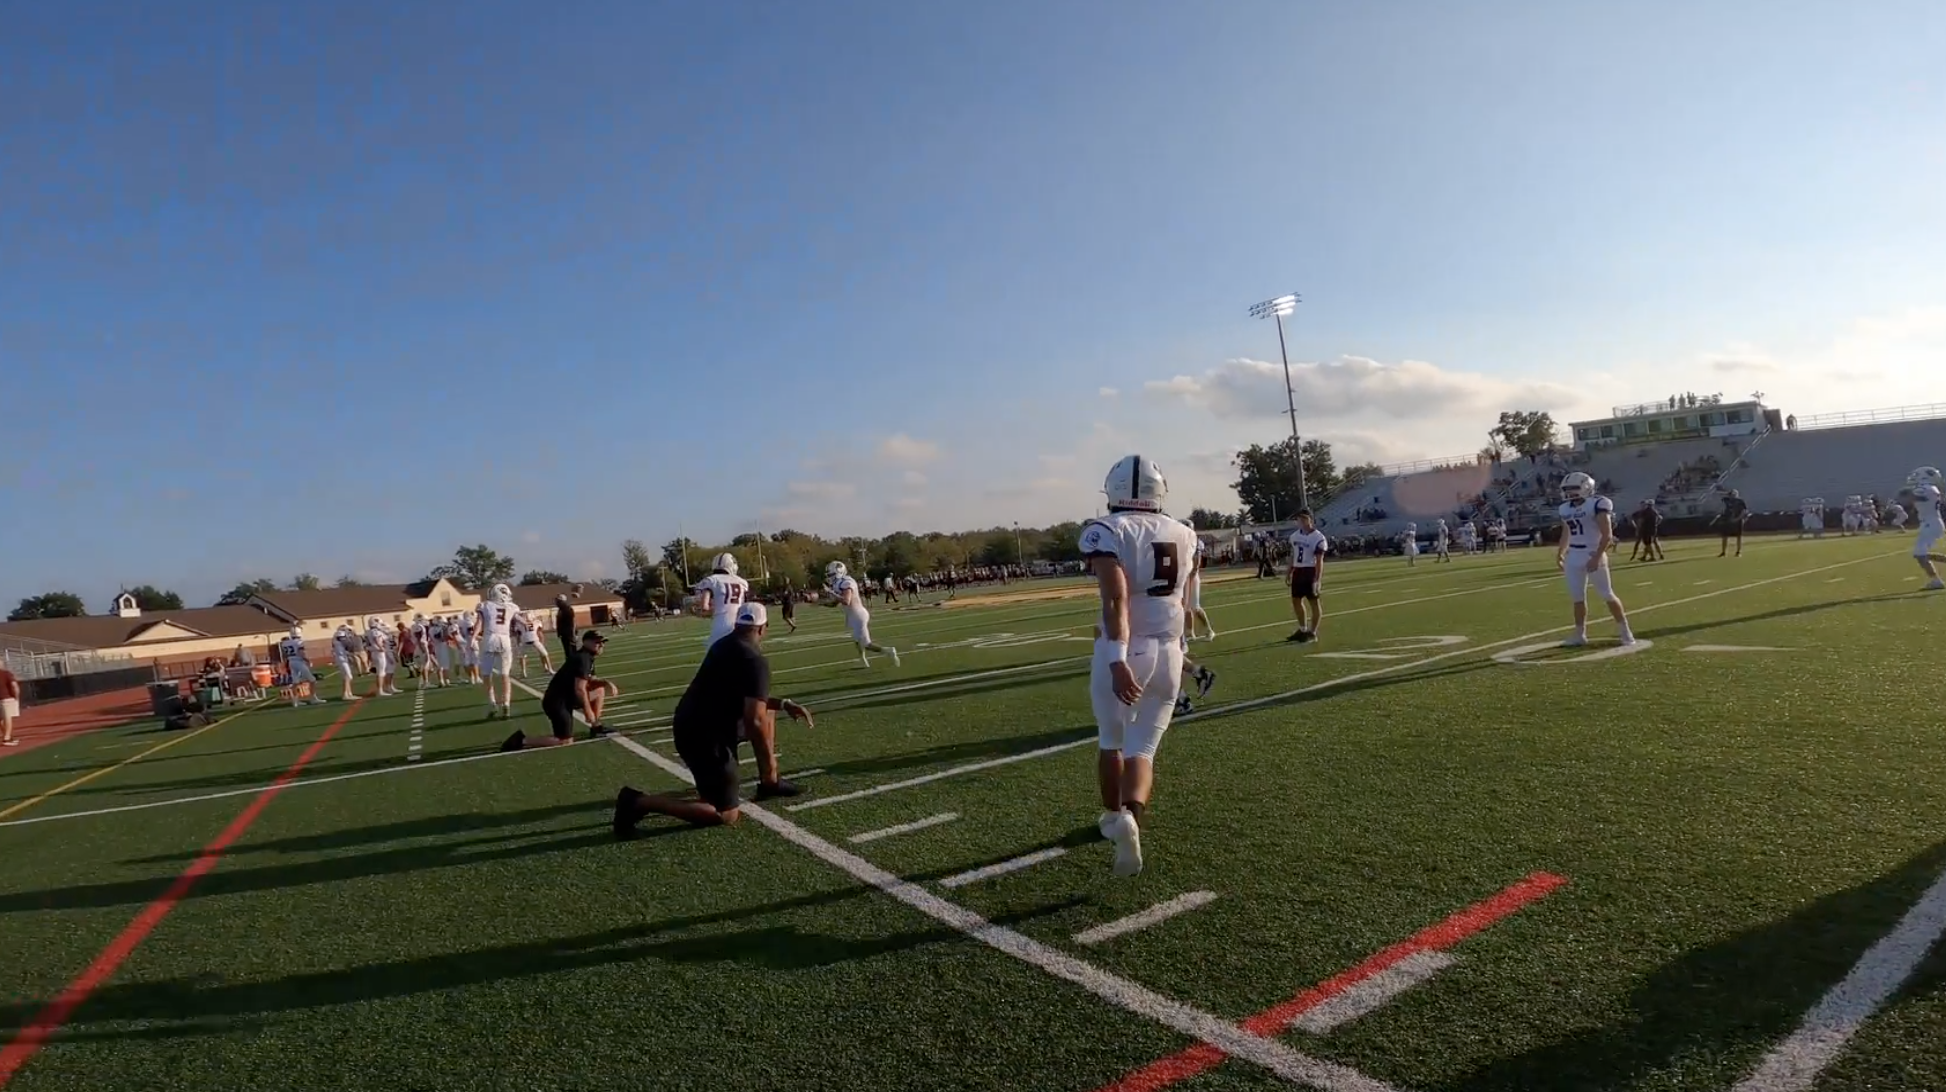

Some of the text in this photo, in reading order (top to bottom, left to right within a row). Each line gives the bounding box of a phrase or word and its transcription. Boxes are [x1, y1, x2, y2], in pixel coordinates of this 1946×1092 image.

[1147, 541, 1178, 597] 9
[723, 582, 741, 604] 19
[495, 608, 506, 625] 3
